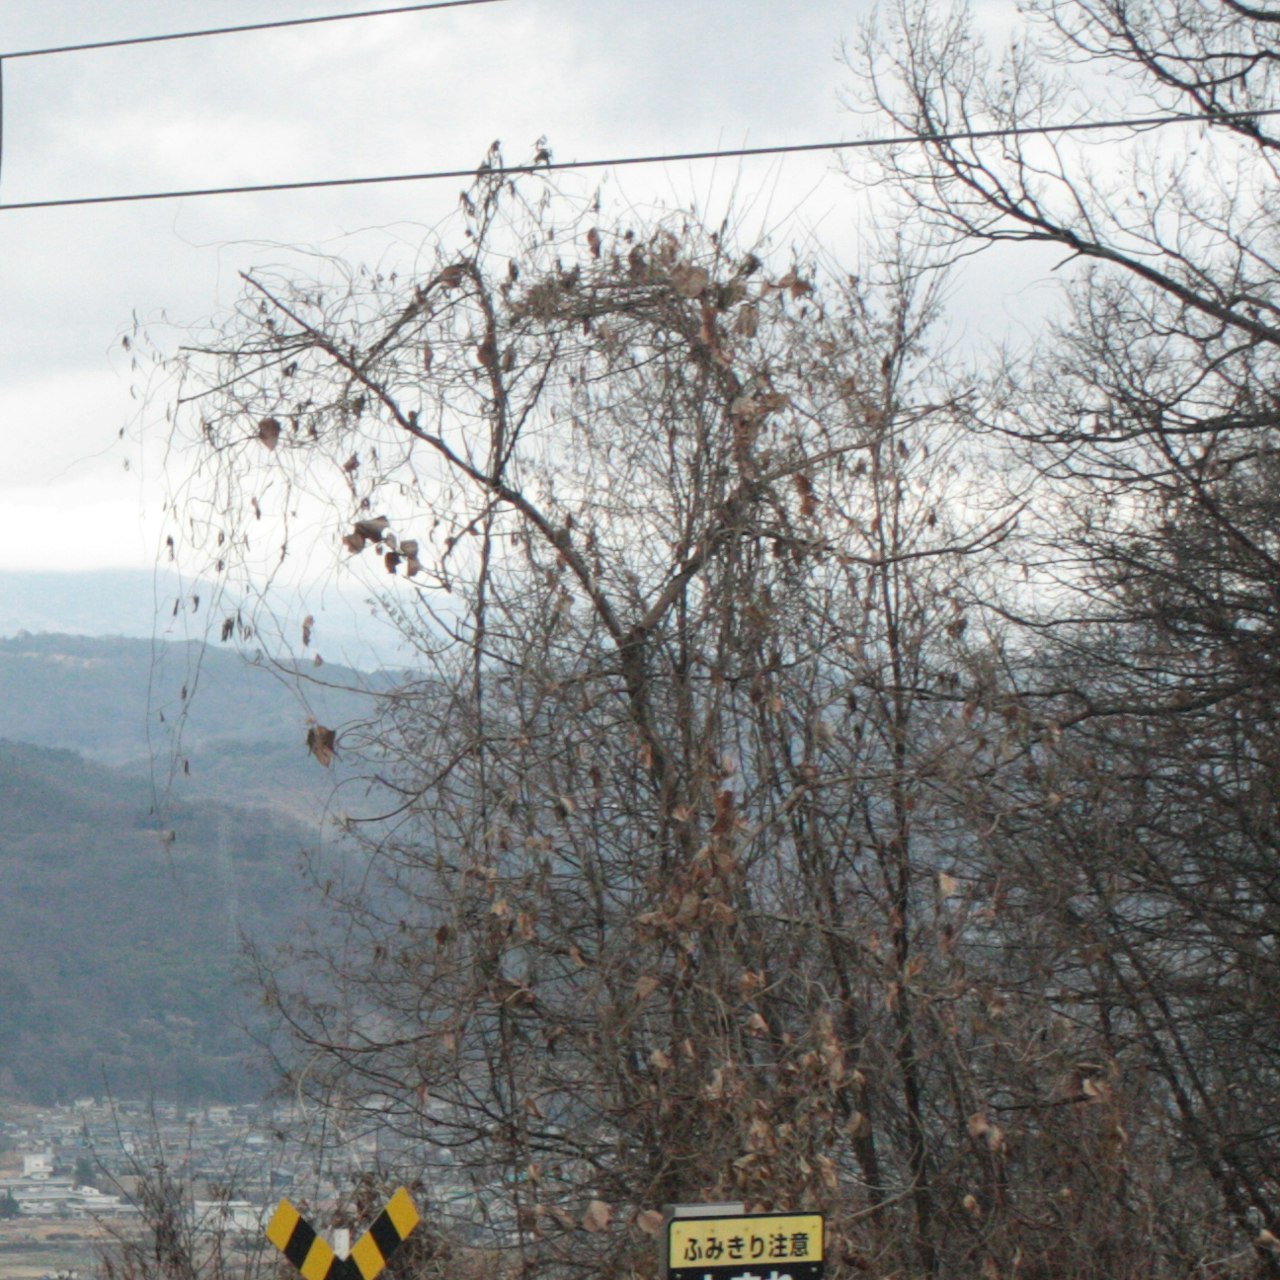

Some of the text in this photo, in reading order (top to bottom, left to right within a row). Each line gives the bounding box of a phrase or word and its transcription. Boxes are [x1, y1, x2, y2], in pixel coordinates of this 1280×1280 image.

[684, 1232, 810, 1262] ふみきり注意
